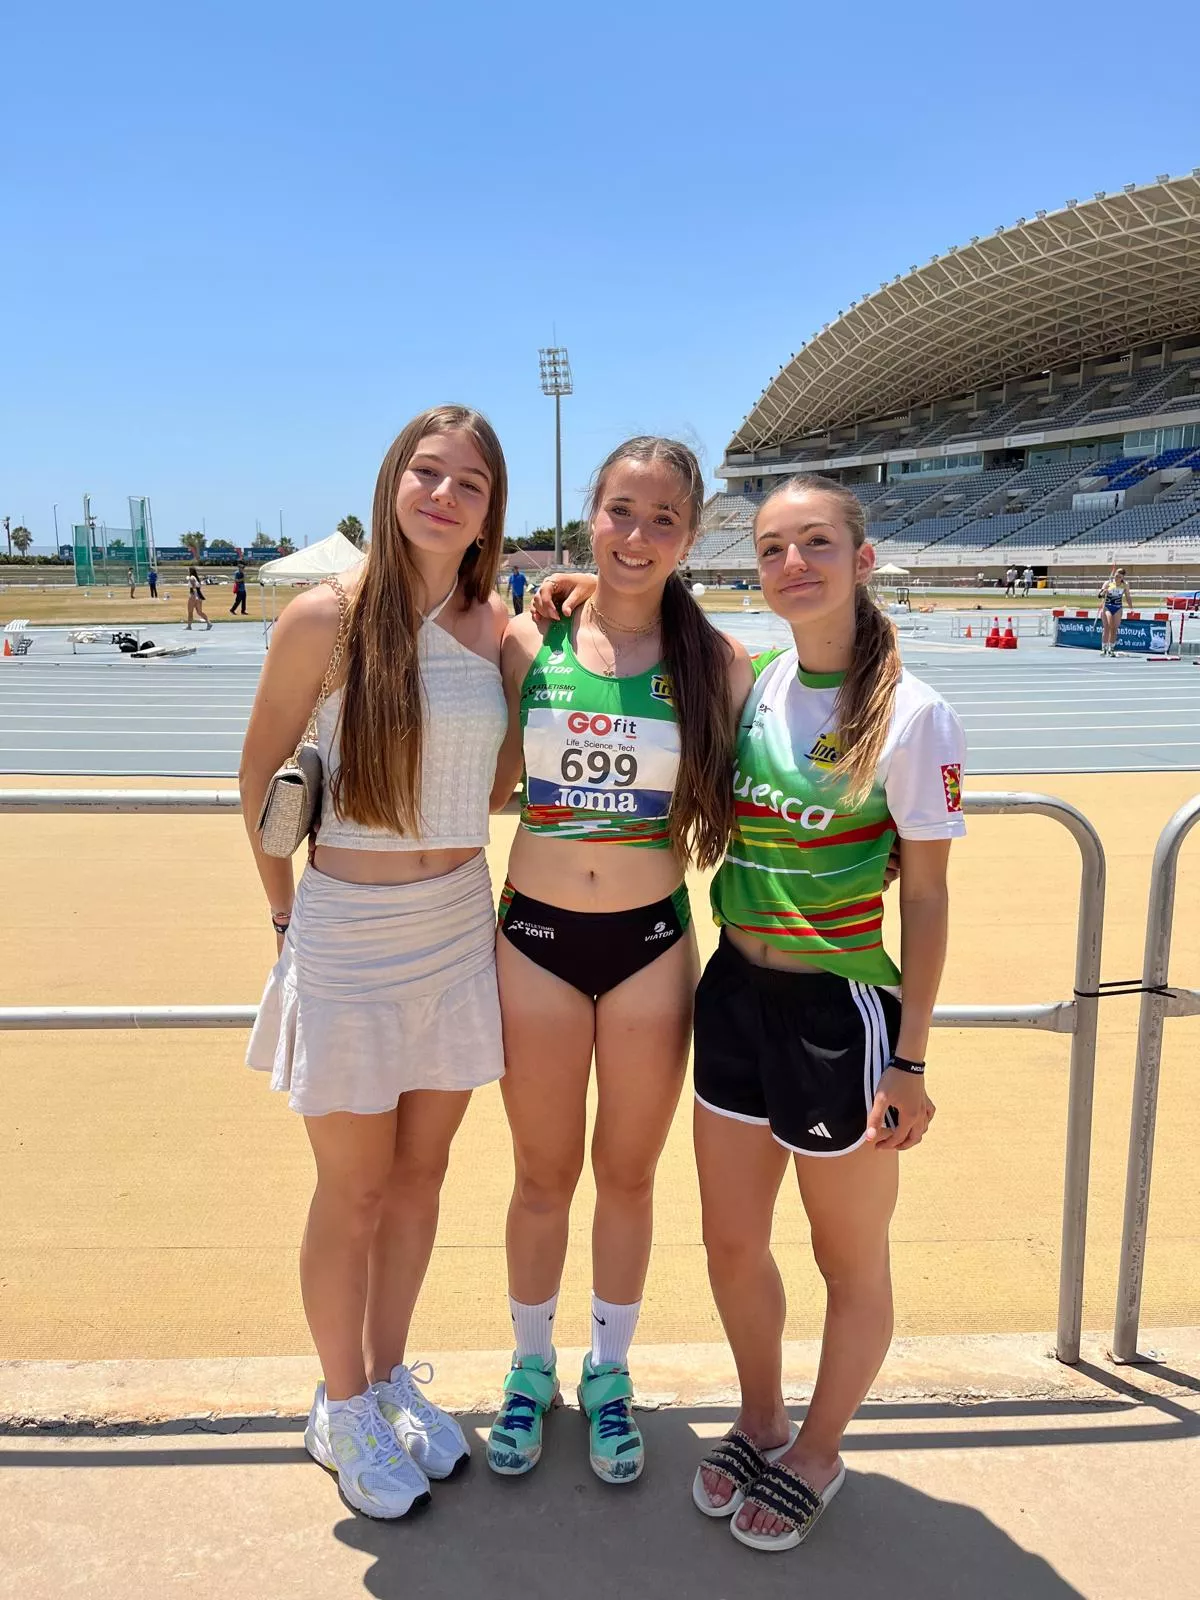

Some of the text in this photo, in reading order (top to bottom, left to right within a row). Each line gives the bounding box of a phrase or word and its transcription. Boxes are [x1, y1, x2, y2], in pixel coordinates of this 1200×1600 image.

[533, 665, 574, 676] VIATOR
[536, 683, 577, 691] ATLETISMO
[533, 690, 574, 703] ZOITI
[561, 748, 638, 787] 699
[554, 788, 638, 813] Joma
[731, 769, 836, 831] uesca
[525, 928, 555, 940] ZOITI
[644, 929, 675, 942] VIATOR
